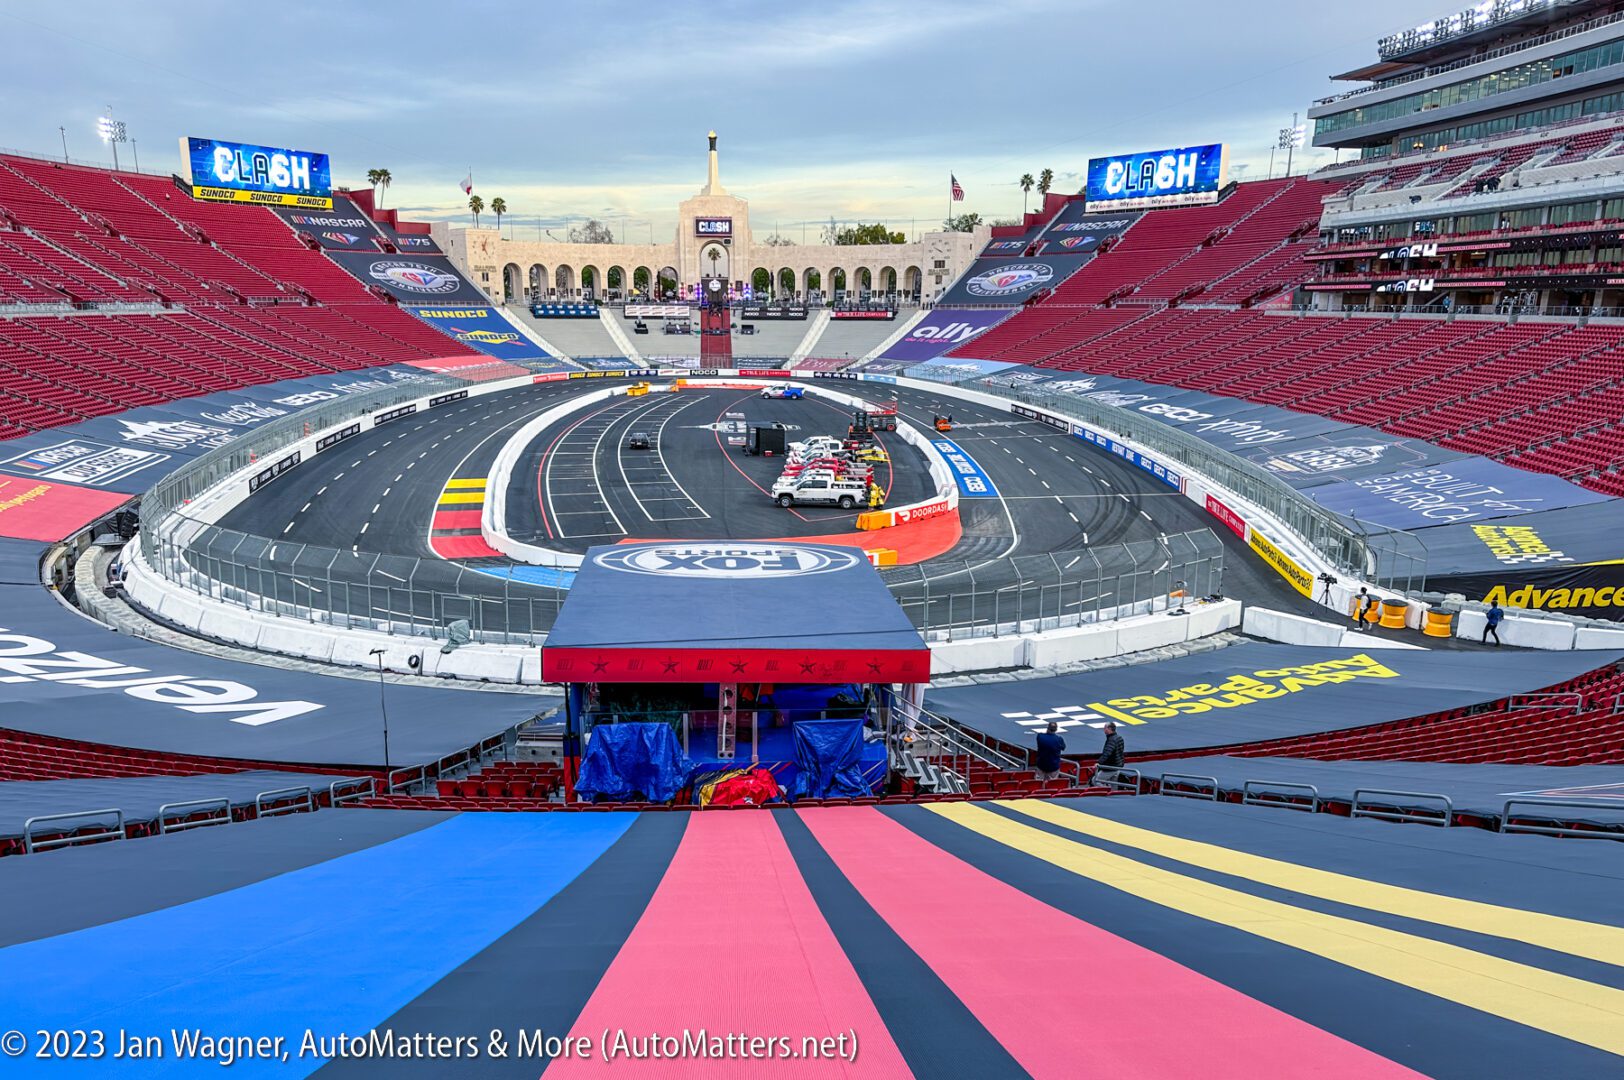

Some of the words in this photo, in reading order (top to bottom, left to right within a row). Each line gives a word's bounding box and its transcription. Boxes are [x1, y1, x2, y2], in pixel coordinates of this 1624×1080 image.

[212, 146, 311, 190] CLASH
[1105, 152, 1198, 195] CLASH
[200, 188, 235, 199] SUNOCO
[250, 193, 283, 203] SUNOCO
[296, 197, 327, 207] SUNOCO
[309, 217, 367, 228] NASCAR
[698, 221, 730, 233] CLASH
[1069, 219, 1130, 230] NASCAR
[414, 238, 431, 246] 75
[1007, 240, 1025, 249] 75
[419, 309, 488, 318] SUNOCO
[457, 332, 519, 341] SUNOCO
[912, 322, 989, 343] ally
[1196, 418, 1297, 445] xfinity
[36, 446, 96, 464] NASCAR
[62, 465, 100, 478] CUP
[1166, 470, 1178, 487] GEICO
[1354, 469, 1443, 487] HOMES
[1410, 474, 1504, 498] BUILT
[1362, 482, 1482, 523] AMERICA
[655, 556, 801, 570] FOX
[1482, 584, 1624, 609] Advance
[1253, 653, 1379, 678] Auto
[1107, 674, 1266, 710] Parts
[1133, 663, 1400, 718] Advance
